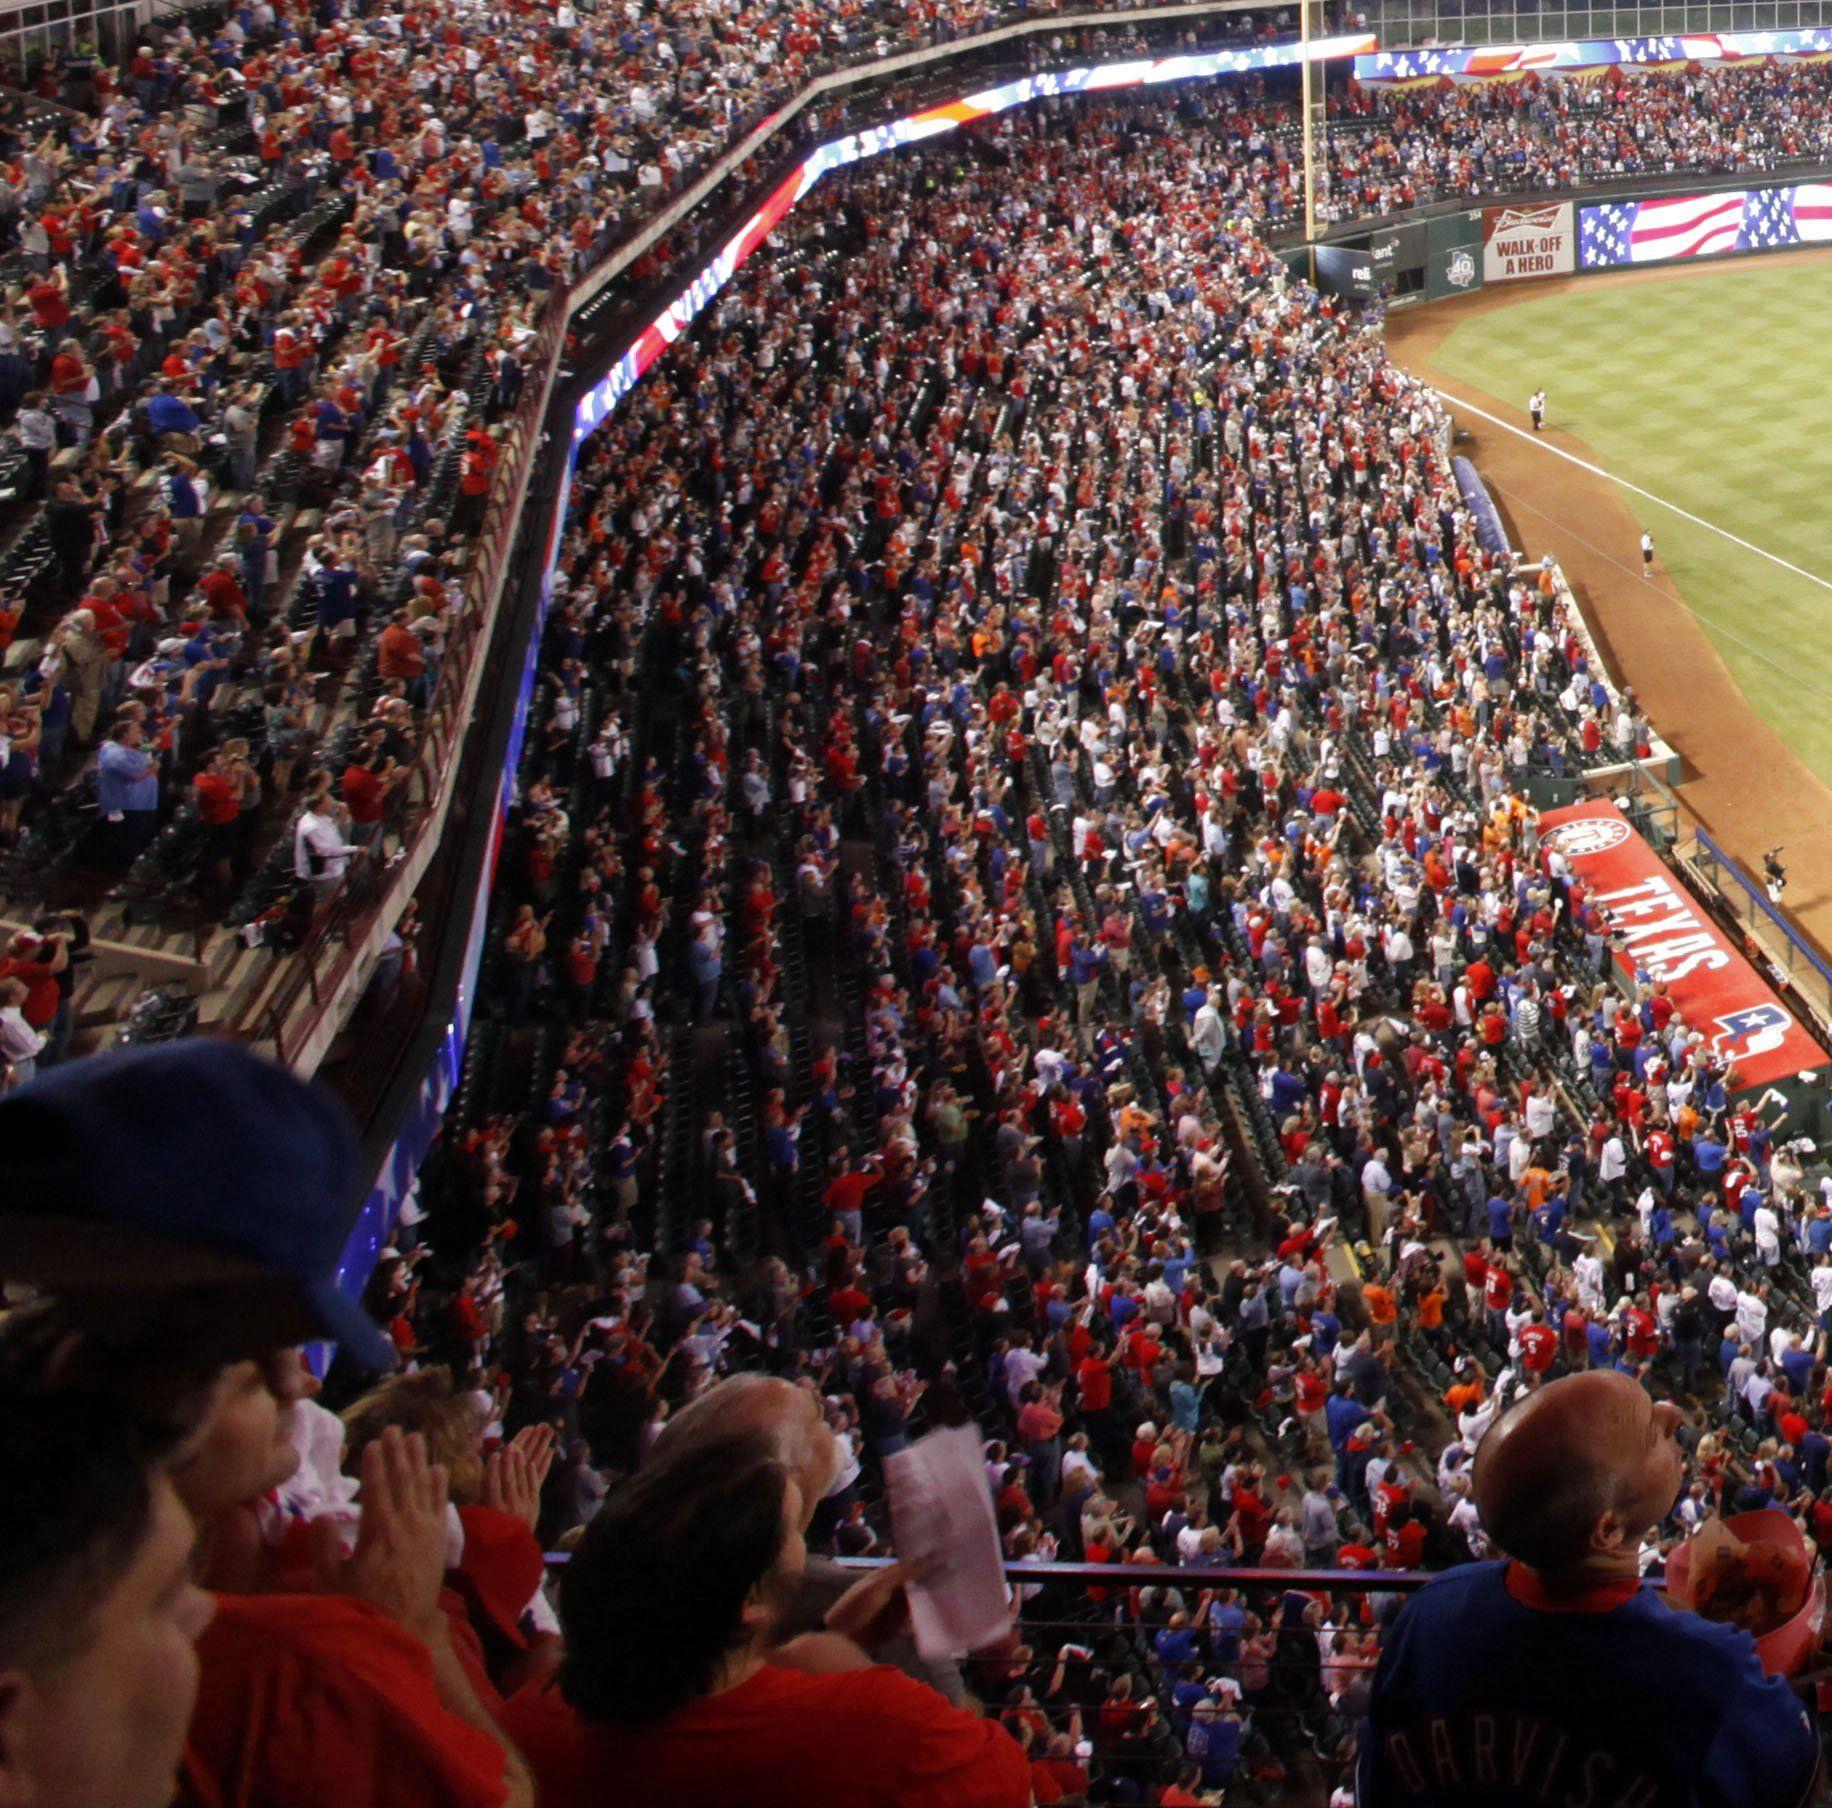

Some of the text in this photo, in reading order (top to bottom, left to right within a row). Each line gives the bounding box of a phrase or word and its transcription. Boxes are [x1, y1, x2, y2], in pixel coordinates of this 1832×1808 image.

[1496, 236, 1562, 258] WALK-OFF
[1506, 255, 1554, 275] A HERO
[1594, 876, 1731, 982] TEXAS
[1528, 1340, 1537, 1355] 5
